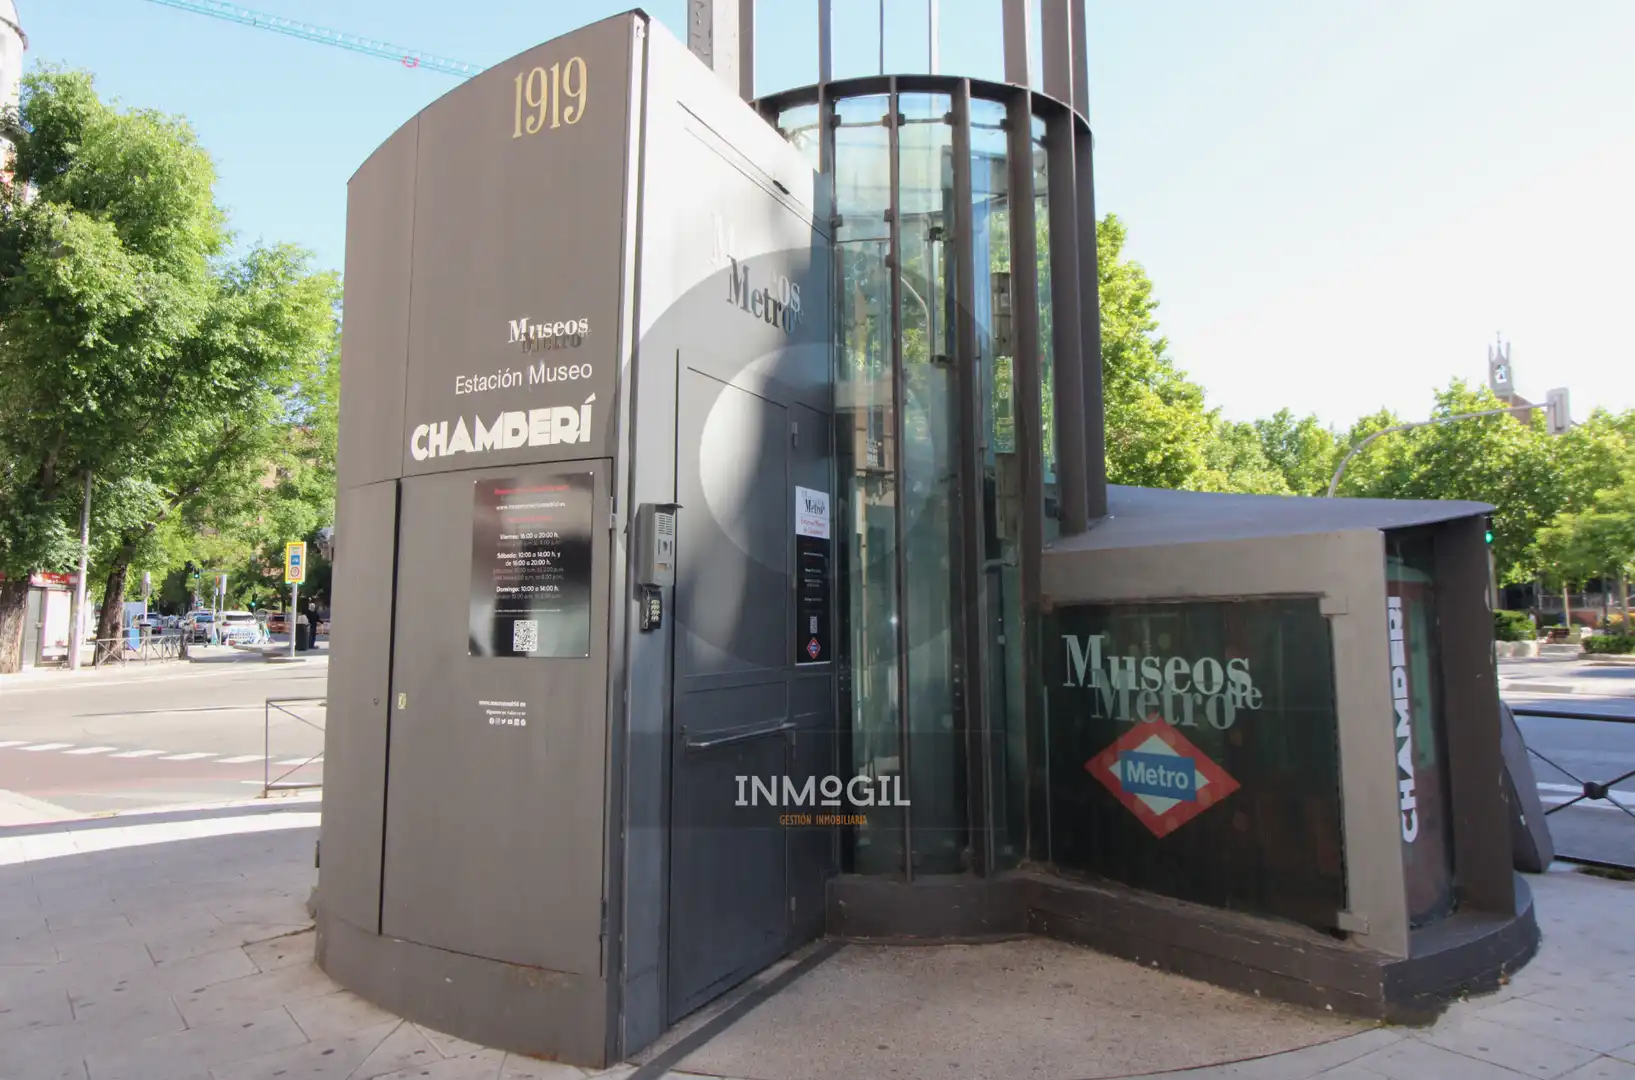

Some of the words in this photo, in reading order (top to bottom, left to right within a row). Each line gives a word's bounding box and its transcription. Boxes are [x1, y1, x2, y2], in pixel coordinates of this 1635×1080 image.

[512, 56, 588, 138] 1919
[726, 254, 796, 337] Metro
[507, 317, 589, 343] Museos
[455, 368, 522, 395] Estación
[529, 362, 593, 385] Museo
[411, 392, 597, 461] CHAMBERÍ
[1061, 634, 1253, 697] Museos
[1089, 669, 1237, 730] Metro
[1126, 760, 1189, 790] Metro
